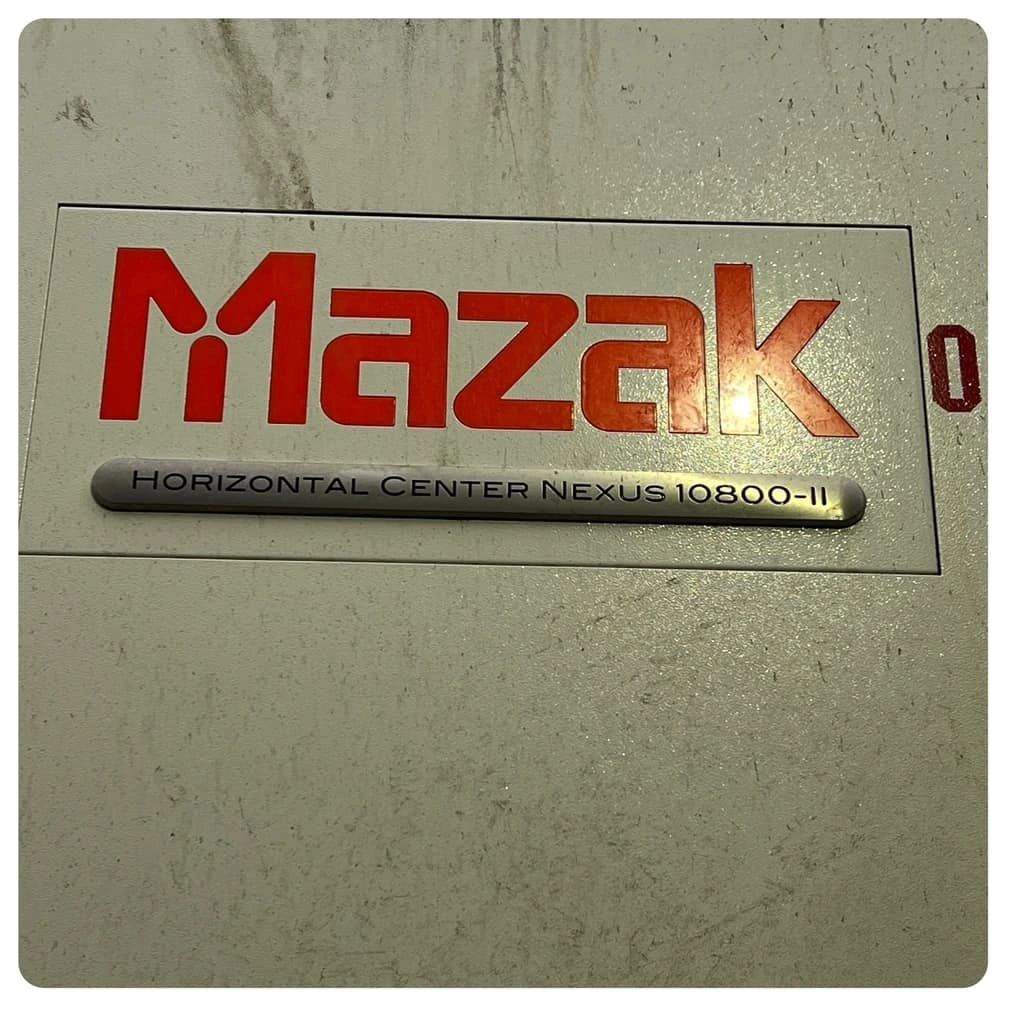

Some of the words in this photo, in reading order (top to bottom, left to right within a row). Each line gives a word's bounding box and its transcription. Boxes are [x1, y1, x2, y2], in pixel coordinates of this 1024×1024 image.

[98, 247, 859, 438] Mazak
[132, 469, 369, 497] HORIZONTAL
[380, 475, 530, 500] CENTER
[541, 479, 666, 503] NEXUS
